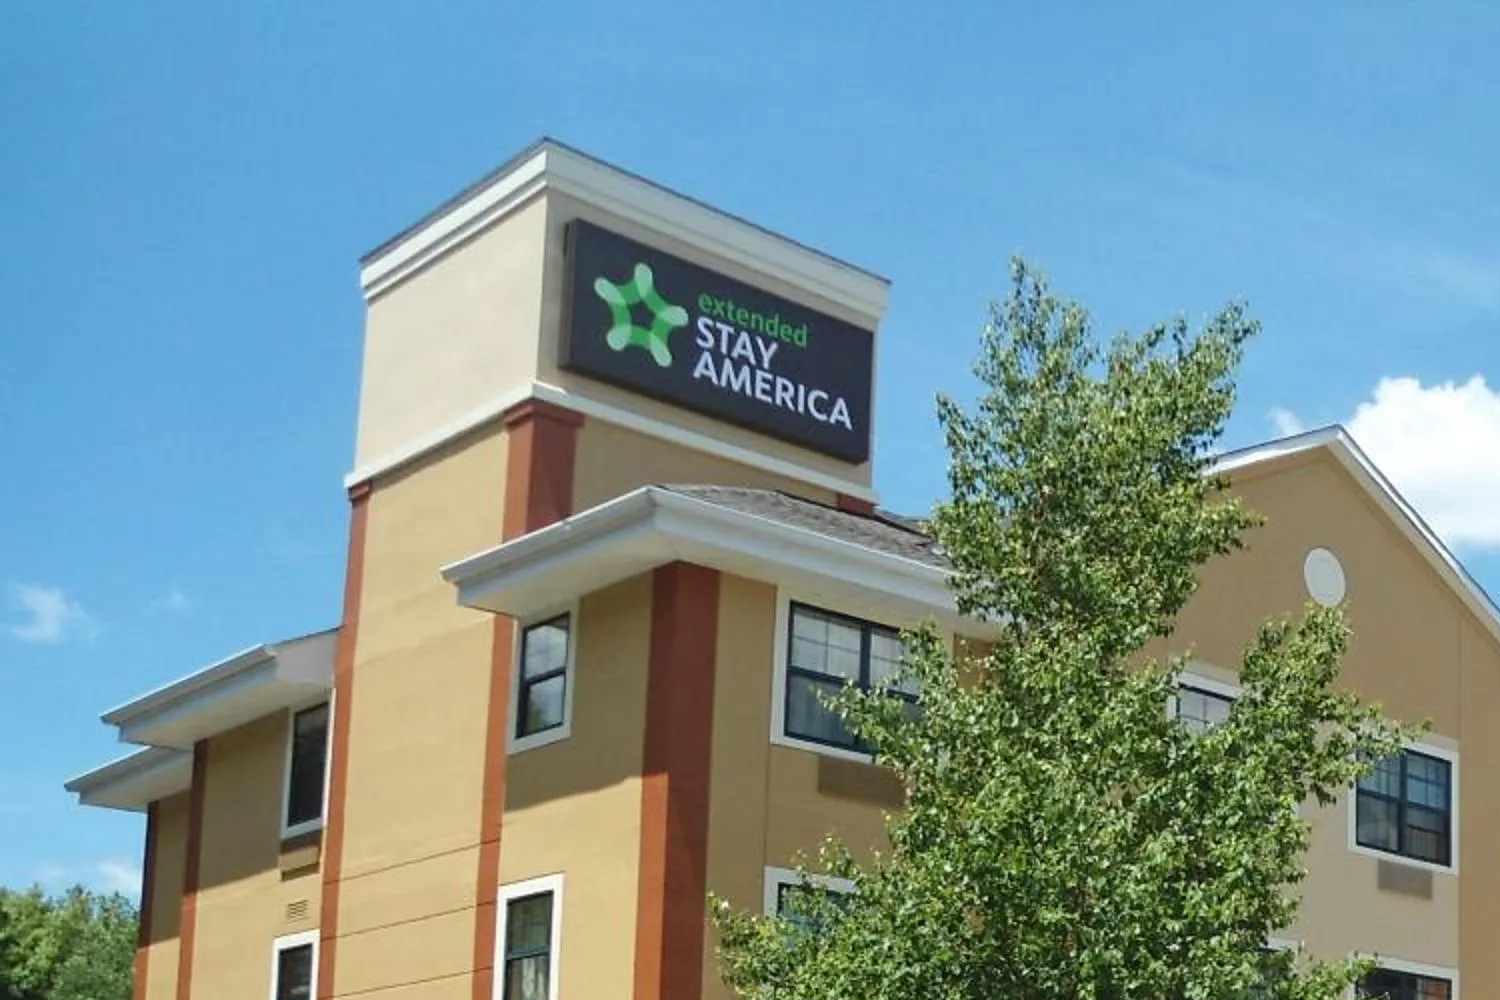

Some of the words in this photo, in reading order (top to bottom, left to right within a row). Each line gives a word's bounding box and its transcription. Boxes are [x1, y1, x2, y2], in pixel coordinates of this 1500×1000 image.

[696, 316, 779, 369] STAY
[699, 294, 807, 347] extended
[694, 350, 853, 430] AMERICA
